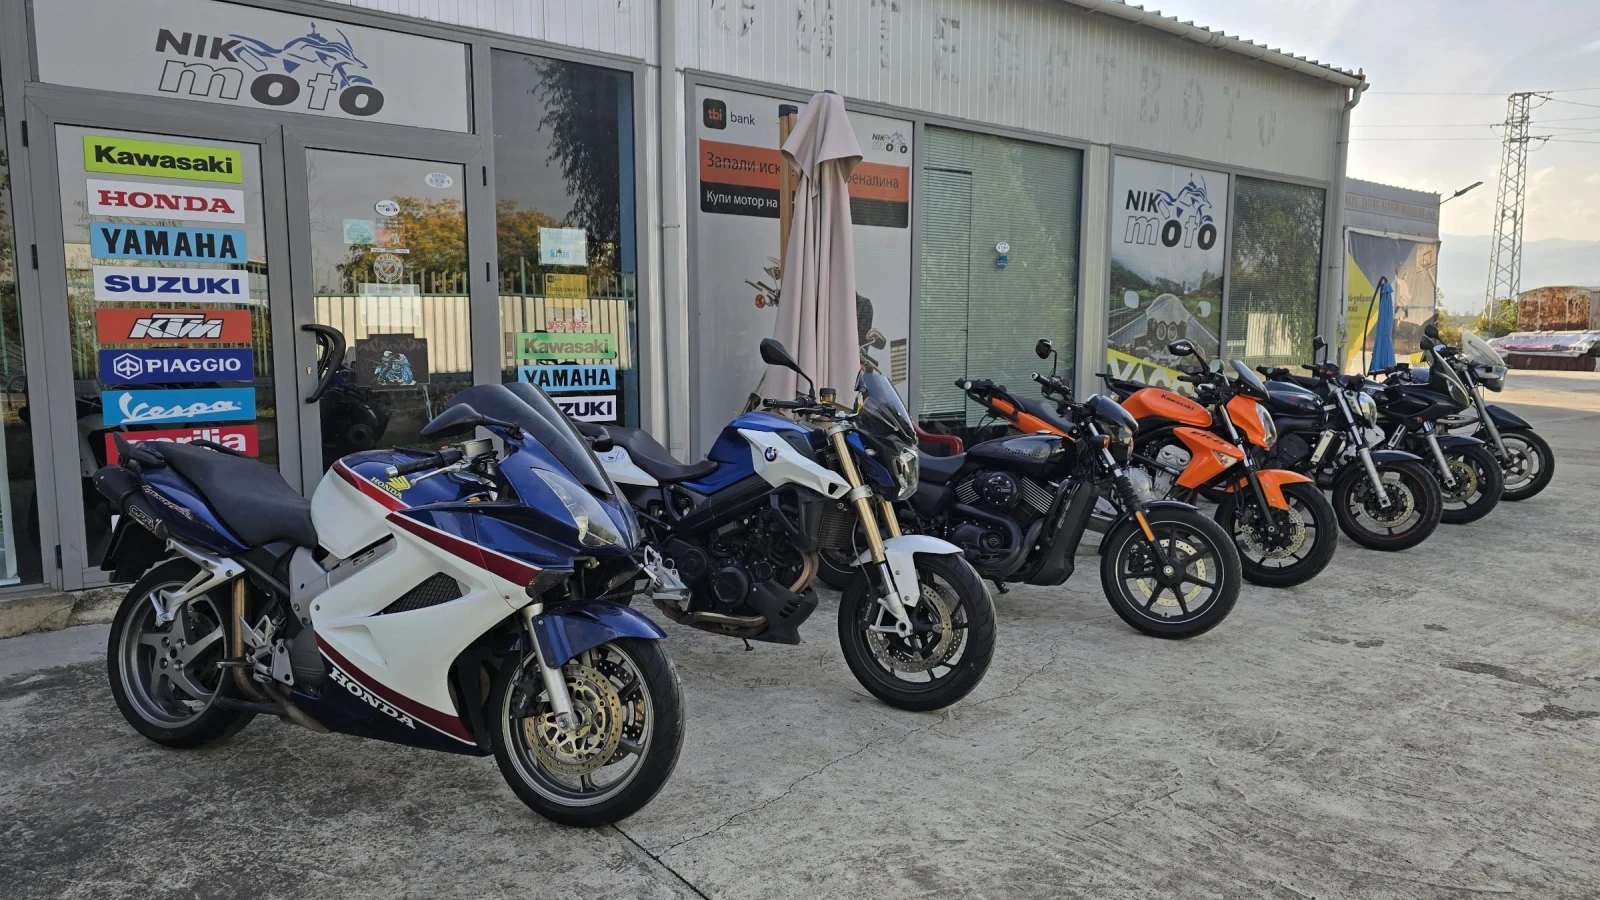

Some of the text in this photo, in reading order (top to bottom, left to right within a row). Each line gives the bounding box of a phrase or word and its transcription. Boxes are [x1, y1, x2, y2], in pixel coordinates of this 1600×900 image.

[155, 28, 243, 63] NIK
[158, 59, 385, 117] moto
[707, 108, 756, 126] tbi bank
[872, 132, 885, 142] NIK
[94, 145, 233, 174] Kawasaki
[707, 152, 756, 172] Запали
[759, 162, 781, 175] иск
[98, 190, 235, 214] HONDA
[706, 190, 778, 209] Купи мотор на
[1126, 189, 1160, 213] NIK
[101, 228, 237, 259] YAMAHA
[1124, 214, 1218, 250] moto
[104, 274, 240, 295] SUZUKI
[127, 313, 224, 340] KTM
[524, 338, 609, 354] Kawasaki
[145, 358, 241, 373] PIAGGIO
[524, 368, 611, 387] YAMAHA
[119, 392, 242, 424] Vespa
[557, 401, 612, 417] ZUKI
[1161, 394, 1194, 411] Kawasaki
[127, 429, 247, 453] rilia
[370, 476, 402, 499] HONDA
[328, 667, 416, 730] HONDA
